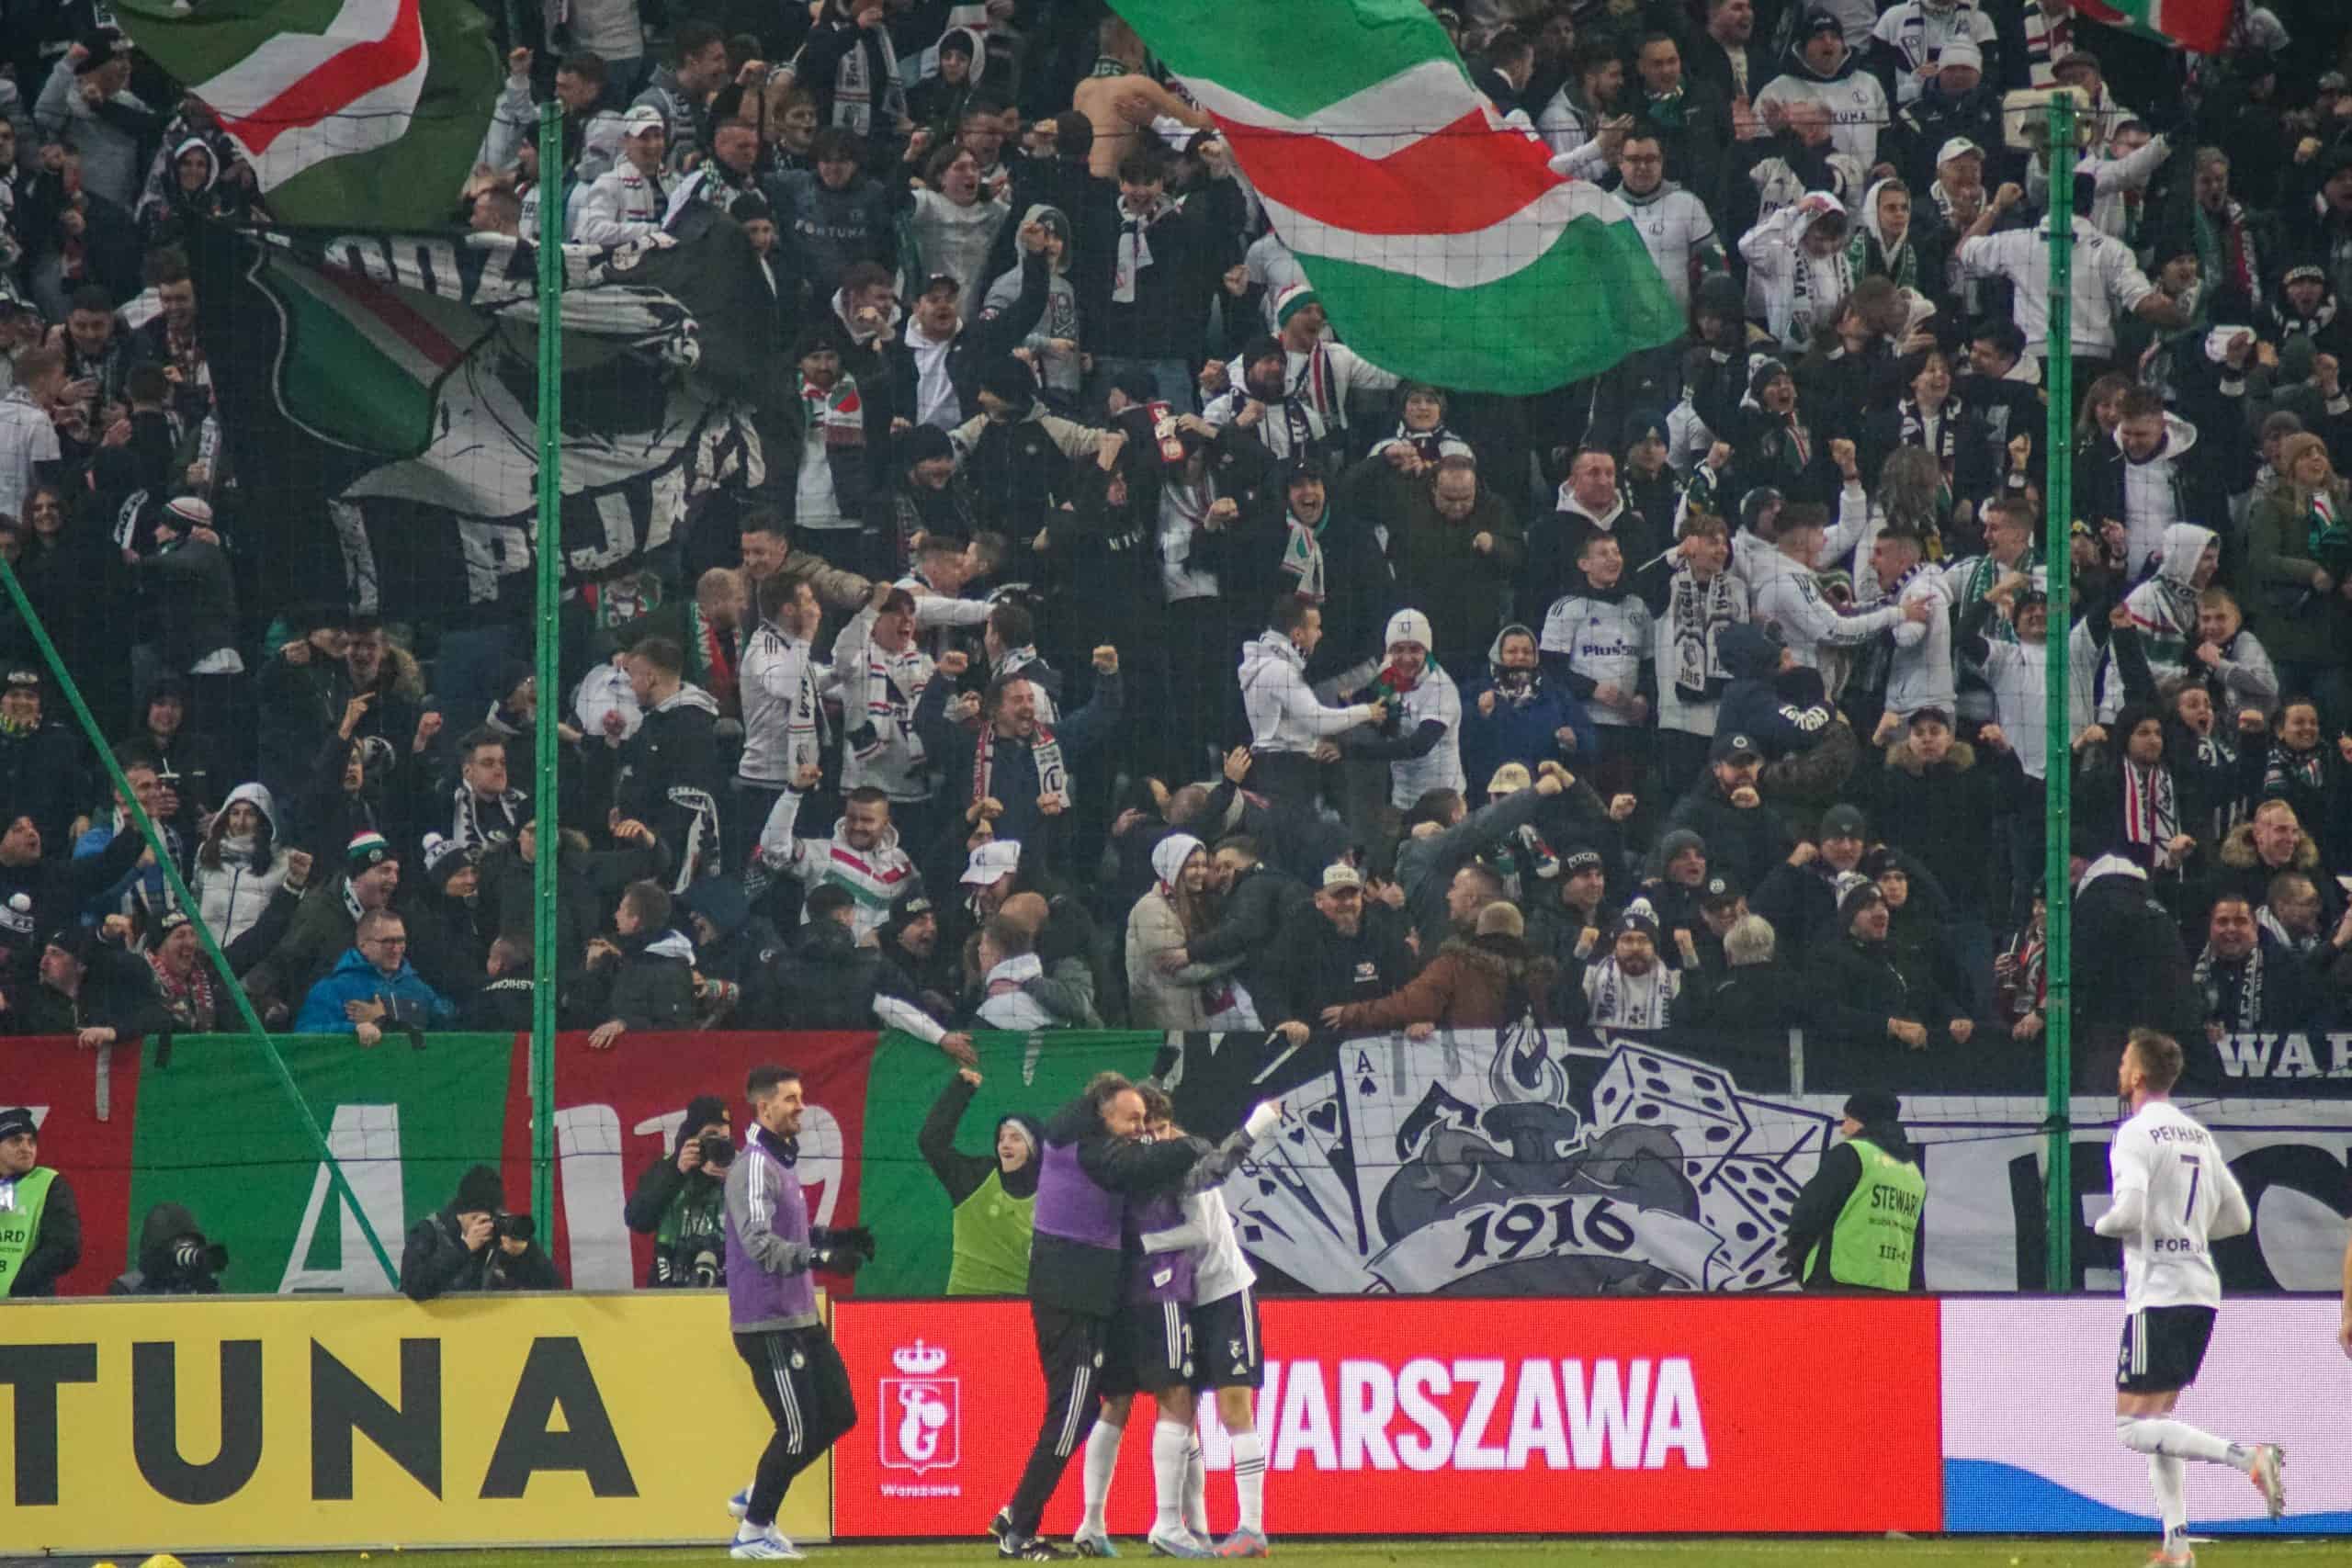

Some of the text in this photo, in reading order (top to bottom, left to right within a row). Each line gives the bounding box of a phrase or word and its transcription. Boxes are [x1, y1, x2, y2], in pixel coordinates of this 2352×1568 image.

[1871, 1183, 1919, 1221] STEWAR
[2181, 1154, 2199, 1225] 7
[1454, 1197, 1634, 1268] 1916
